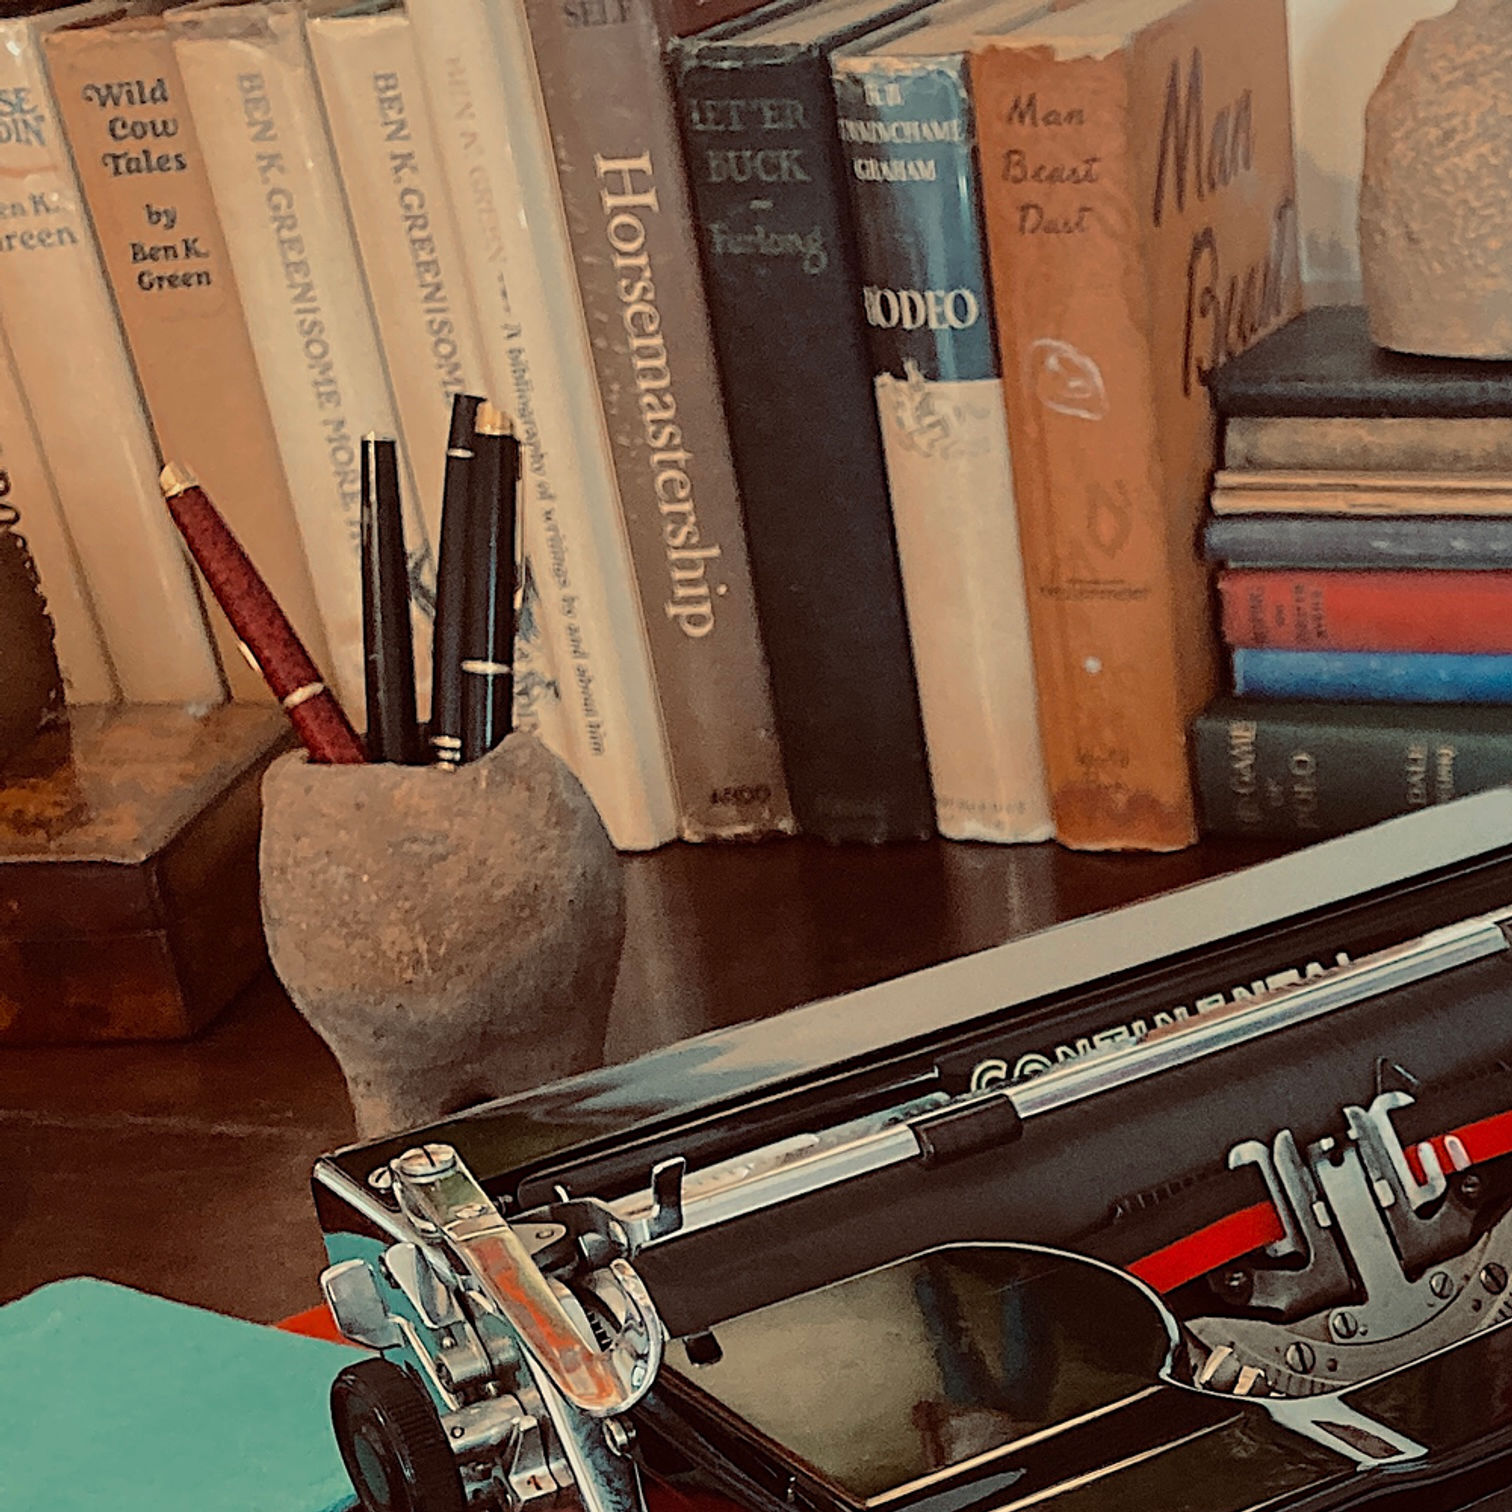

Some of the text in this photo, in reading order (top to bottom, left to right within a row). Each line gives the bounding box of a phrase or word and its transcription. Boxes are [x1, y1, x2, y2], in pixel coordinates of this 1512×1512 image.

[81, 78, 168, 108] Wild
[237, 73, 278, 142] BEN
[373, 72, 411, 142] BEN
[690, 99, 747, 131] LET
[1007, 92, 1085, 128] Man
[109, 117, 179, 140] Cow
[1153, 47, 1253, 228] Man
[102, 149, 187, 176] Tales
[706, 150, 813, 183] BUCK
[1001, 149, 1102, 184] Beast
[145, 203, 177, 230] by
[130, 242, 178, 264] Ben
[137, 269, 212, 291] Green
[593, 152, 728, 638] Horsemastership
[970, 952, 1352, 1093] CONTINENT
